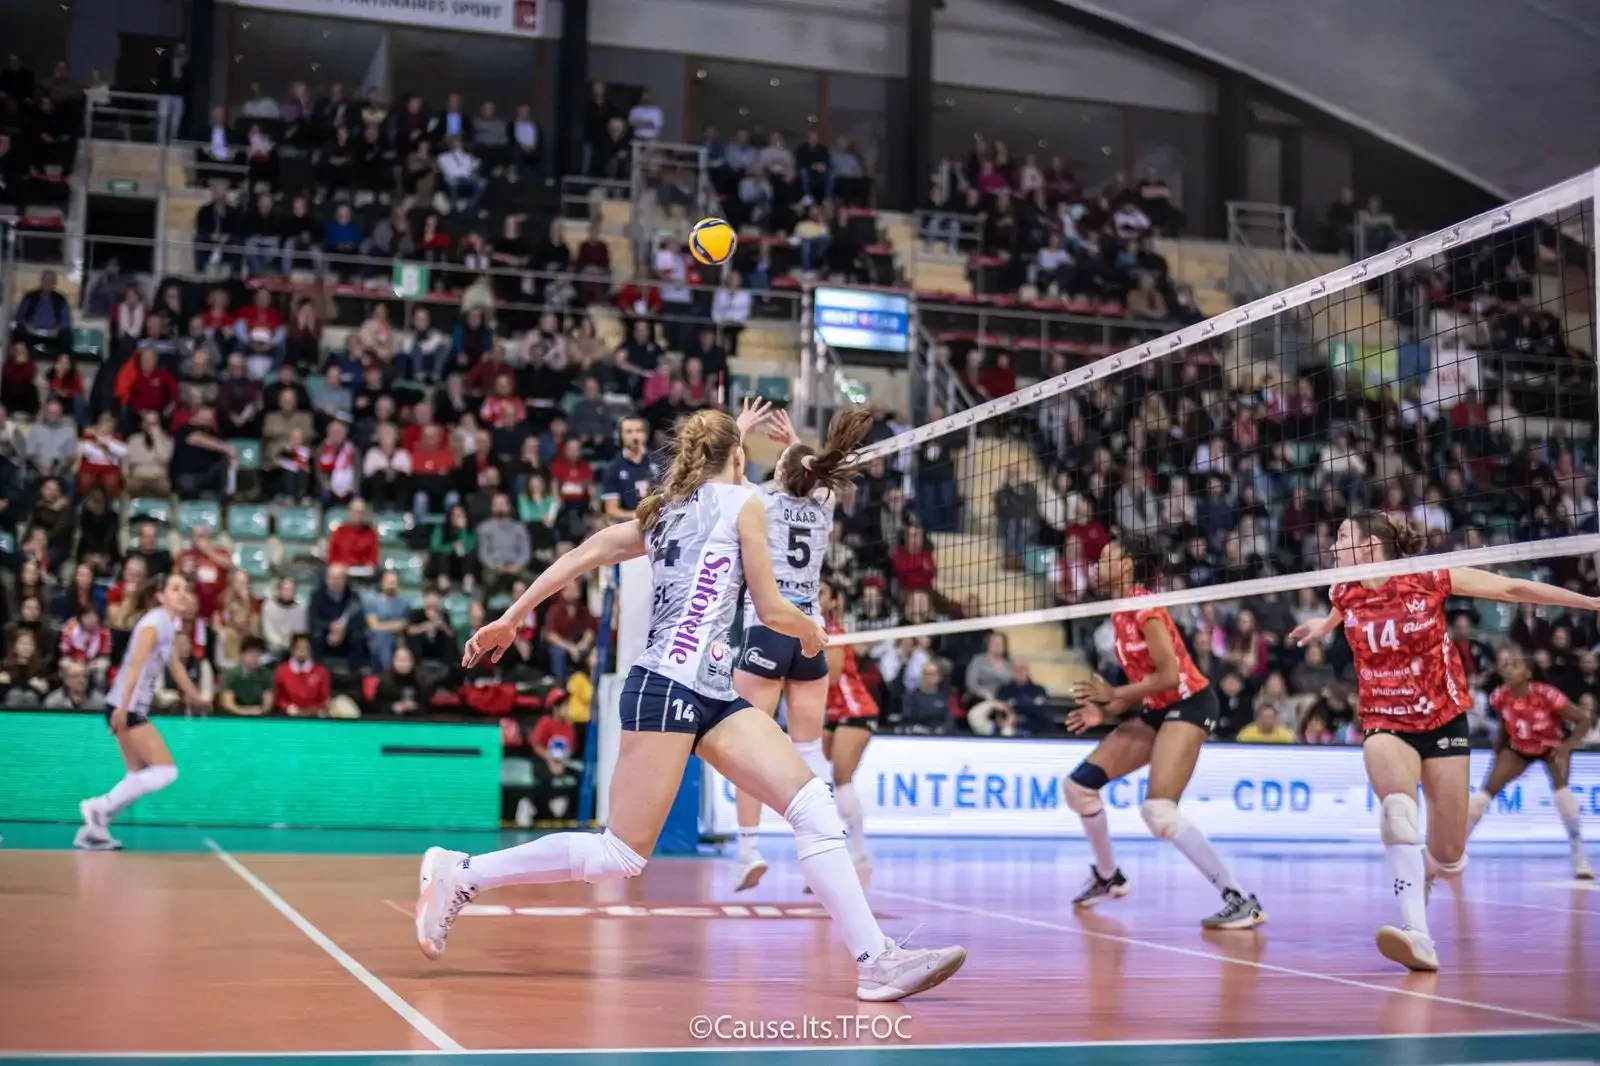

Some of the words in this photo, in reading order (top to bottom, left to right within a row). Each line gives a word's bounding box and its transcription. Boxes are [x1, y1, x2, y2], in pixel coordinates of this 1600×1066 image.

[450, 3, 504, 20] SPORT
[783, 508, 817, 523] GLAAB
[786, 526, 811, 569] 5
[668, 551, 731, 665] Saforelle
[1361, 618, 1400, 653] 14
[671, 698, 696, 723] 14
[876, 766, 1060, 809] INTÉRIM
[1233, 780, 1315, 813] CDD
